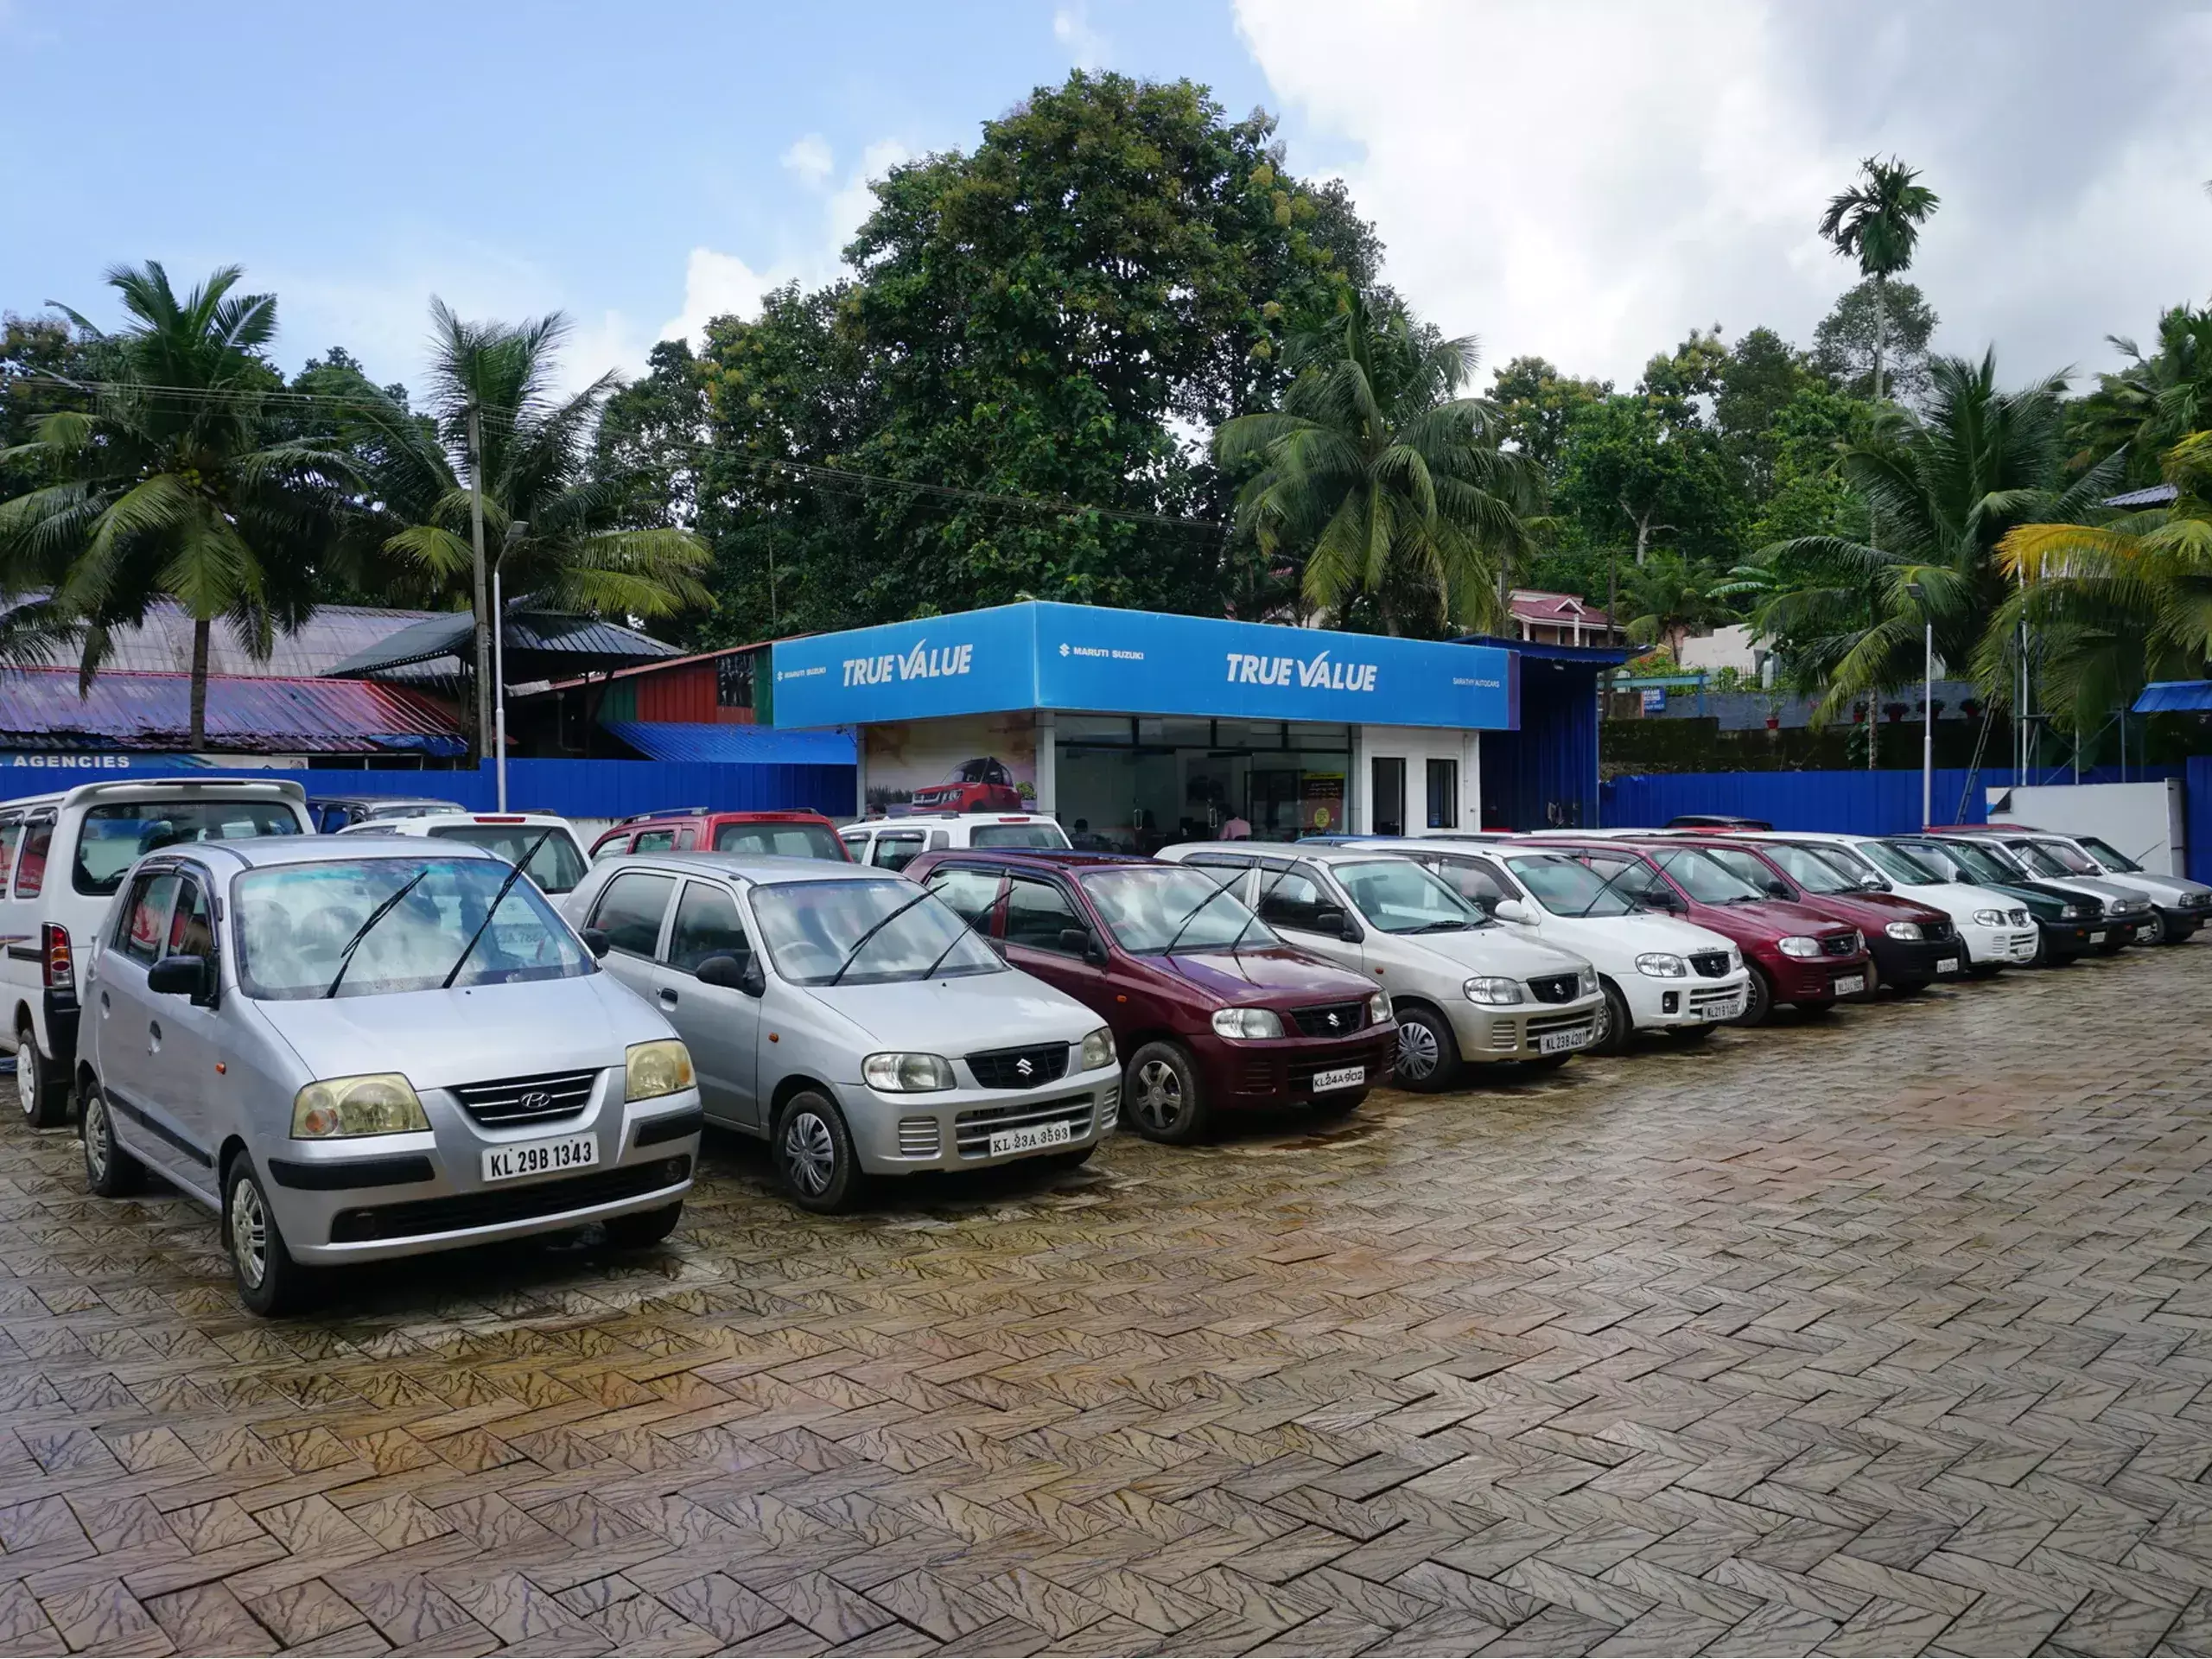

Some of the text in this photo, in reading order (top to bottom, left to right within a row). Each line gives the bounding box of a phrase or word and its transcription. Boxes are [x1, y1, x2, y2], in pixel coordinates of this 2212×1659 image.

[843, 639, 973, 687] TRUE VALUE
[1073, 646, 1144, 660] MARUTI SUZUKI
[1227, 650, 1377, 691] TRUE VALUE
[13, 755, 130, 768] AGENCIES
